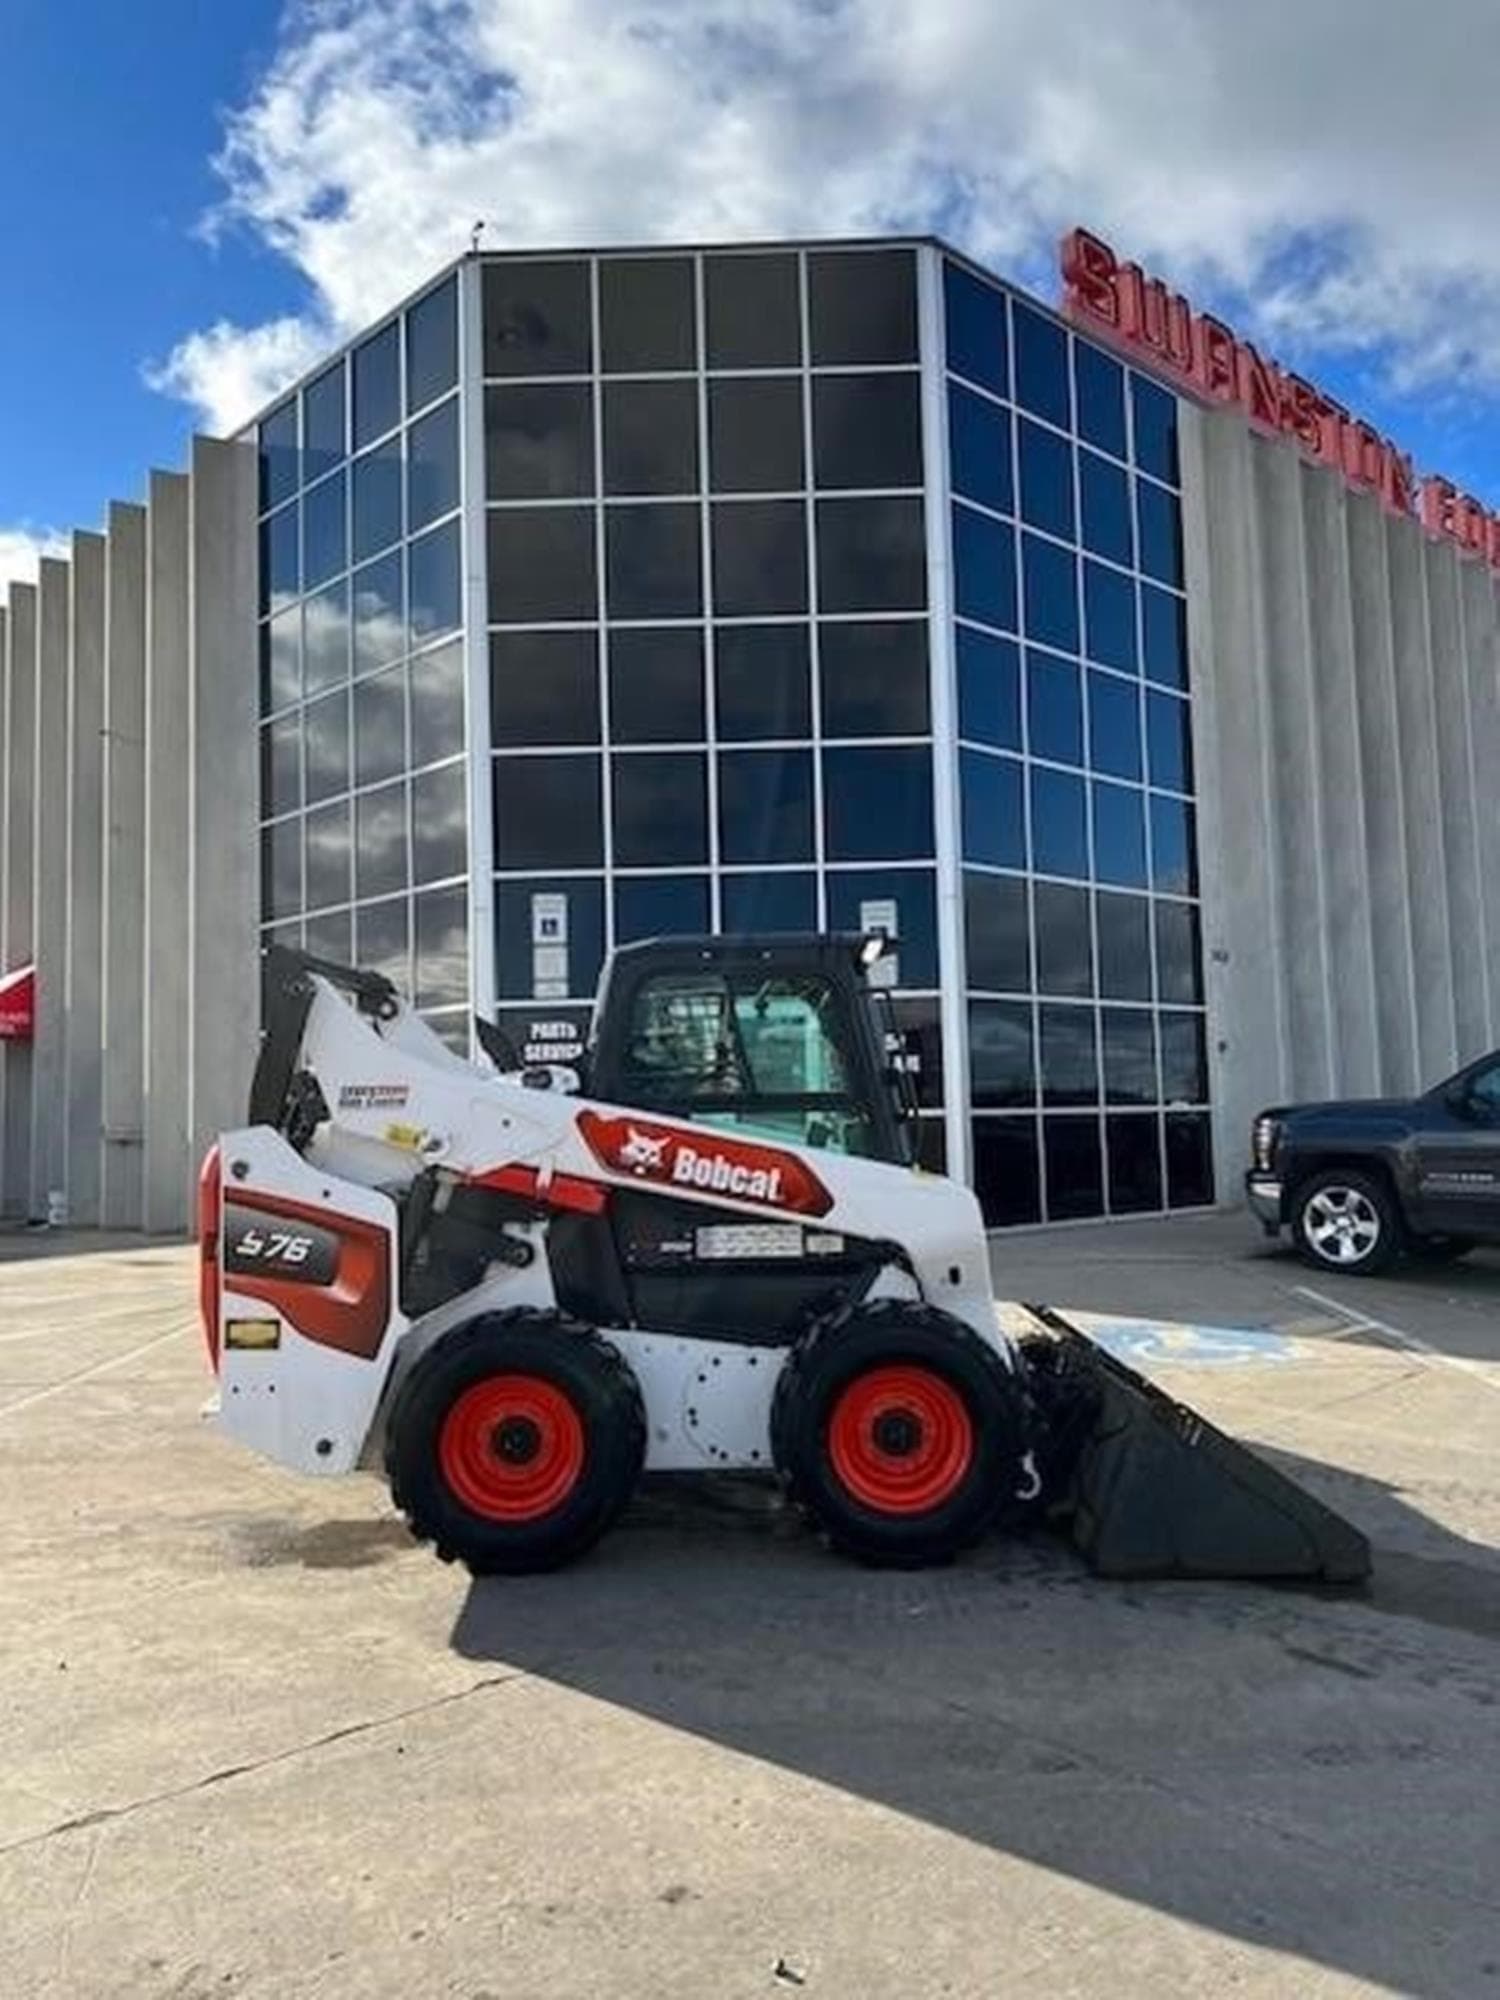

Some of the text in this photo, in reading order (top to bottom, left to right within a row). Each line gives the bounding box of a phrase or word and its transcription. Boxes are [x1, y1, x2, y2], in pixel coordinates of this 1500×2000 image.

[1061, 227, 1414, 518] SWANSTON
[673, 1147, 782, 1200] Bobcat
[236, 1229, 313, 1262] S76
